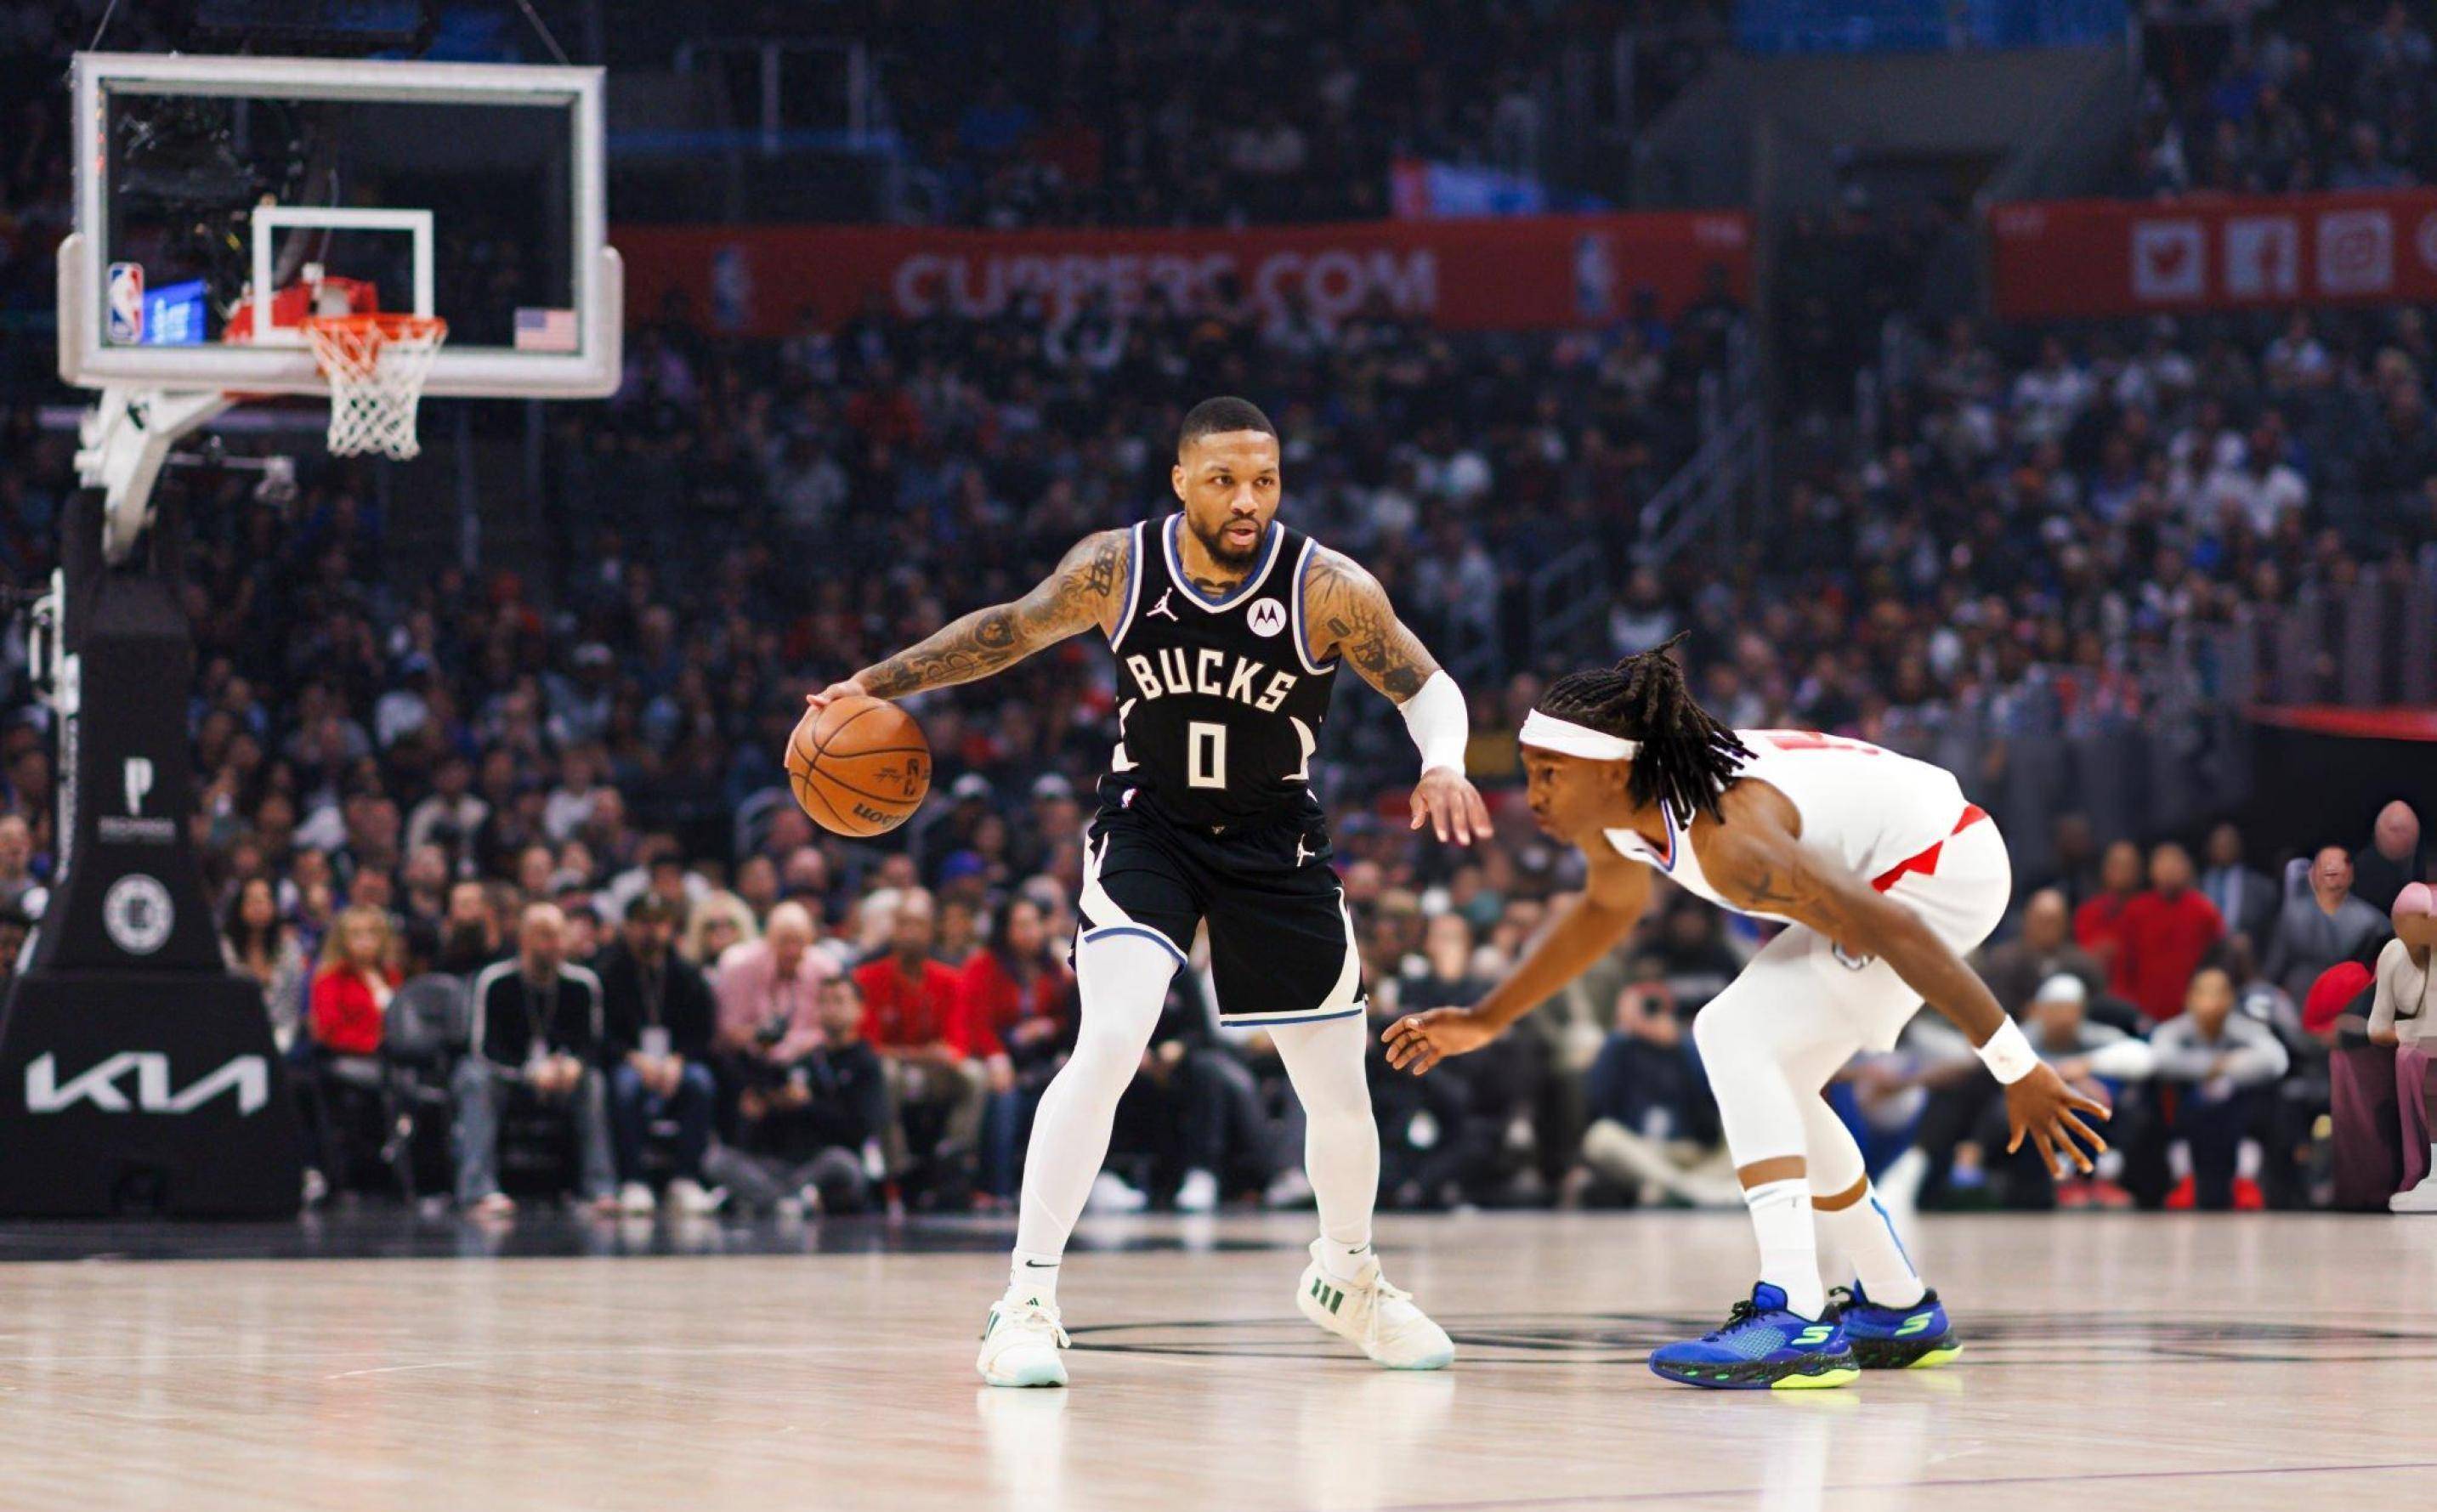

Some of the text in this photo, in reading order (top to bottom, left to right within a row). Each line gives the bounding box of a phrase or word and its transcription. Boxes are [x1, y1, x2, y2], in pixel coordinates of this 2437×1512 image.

[1125, 648, 1298, 713] BUCKS
[1187, 721, 1227, 790] 0
[25, 1050, 269, 1115] KIA
